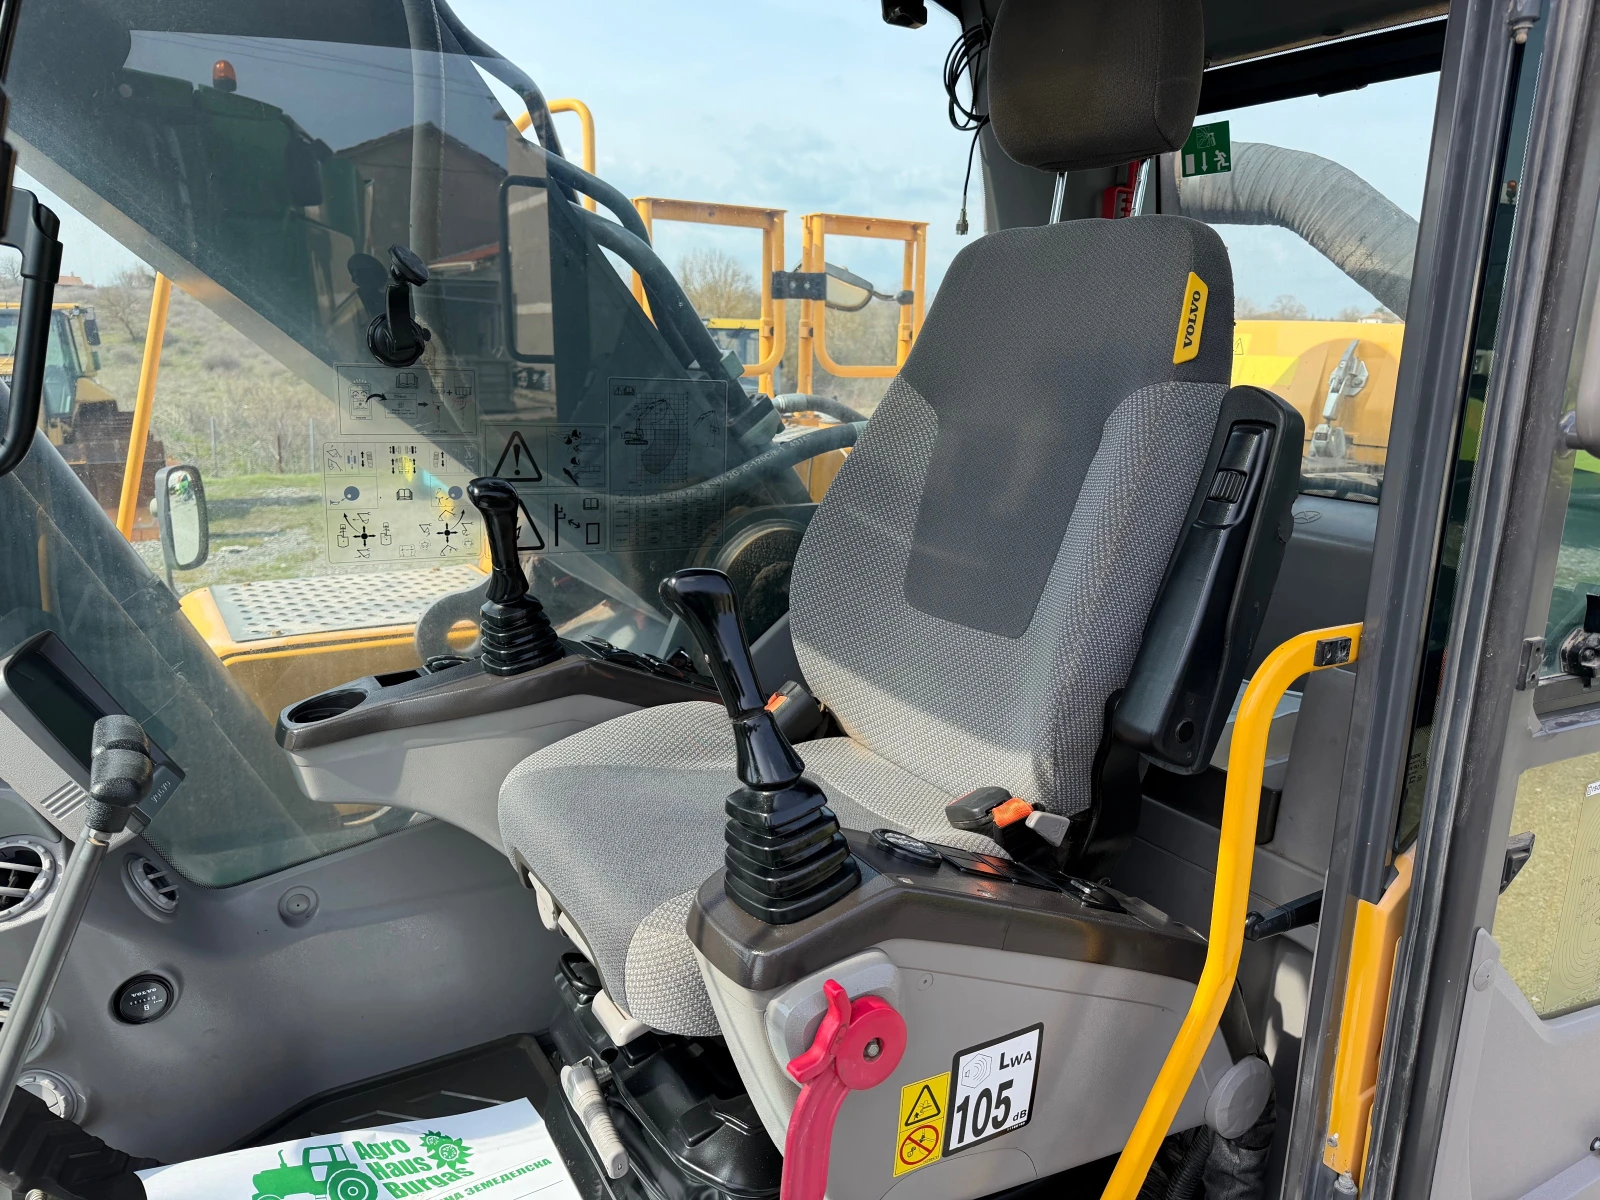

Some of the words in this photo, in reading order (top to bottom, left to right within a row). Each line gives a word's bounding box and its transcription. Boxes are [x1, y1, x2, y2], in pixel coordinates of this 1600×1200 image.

[1183, 290, 1201, 349] VOLVO
[999, 1051, 1033, 1071] LWA
[956, 1079, 1014, 1145] 105
[1013, 1109, 1027, 1122] dB
[352, 1138, 411, 1161] Agro
[365, 1156, 432, 1181] Haus
[382, 1167, 475, 1199] Burgas
[464, 1158, 552, 1196] ЗЕМЕДЕЛСКА
